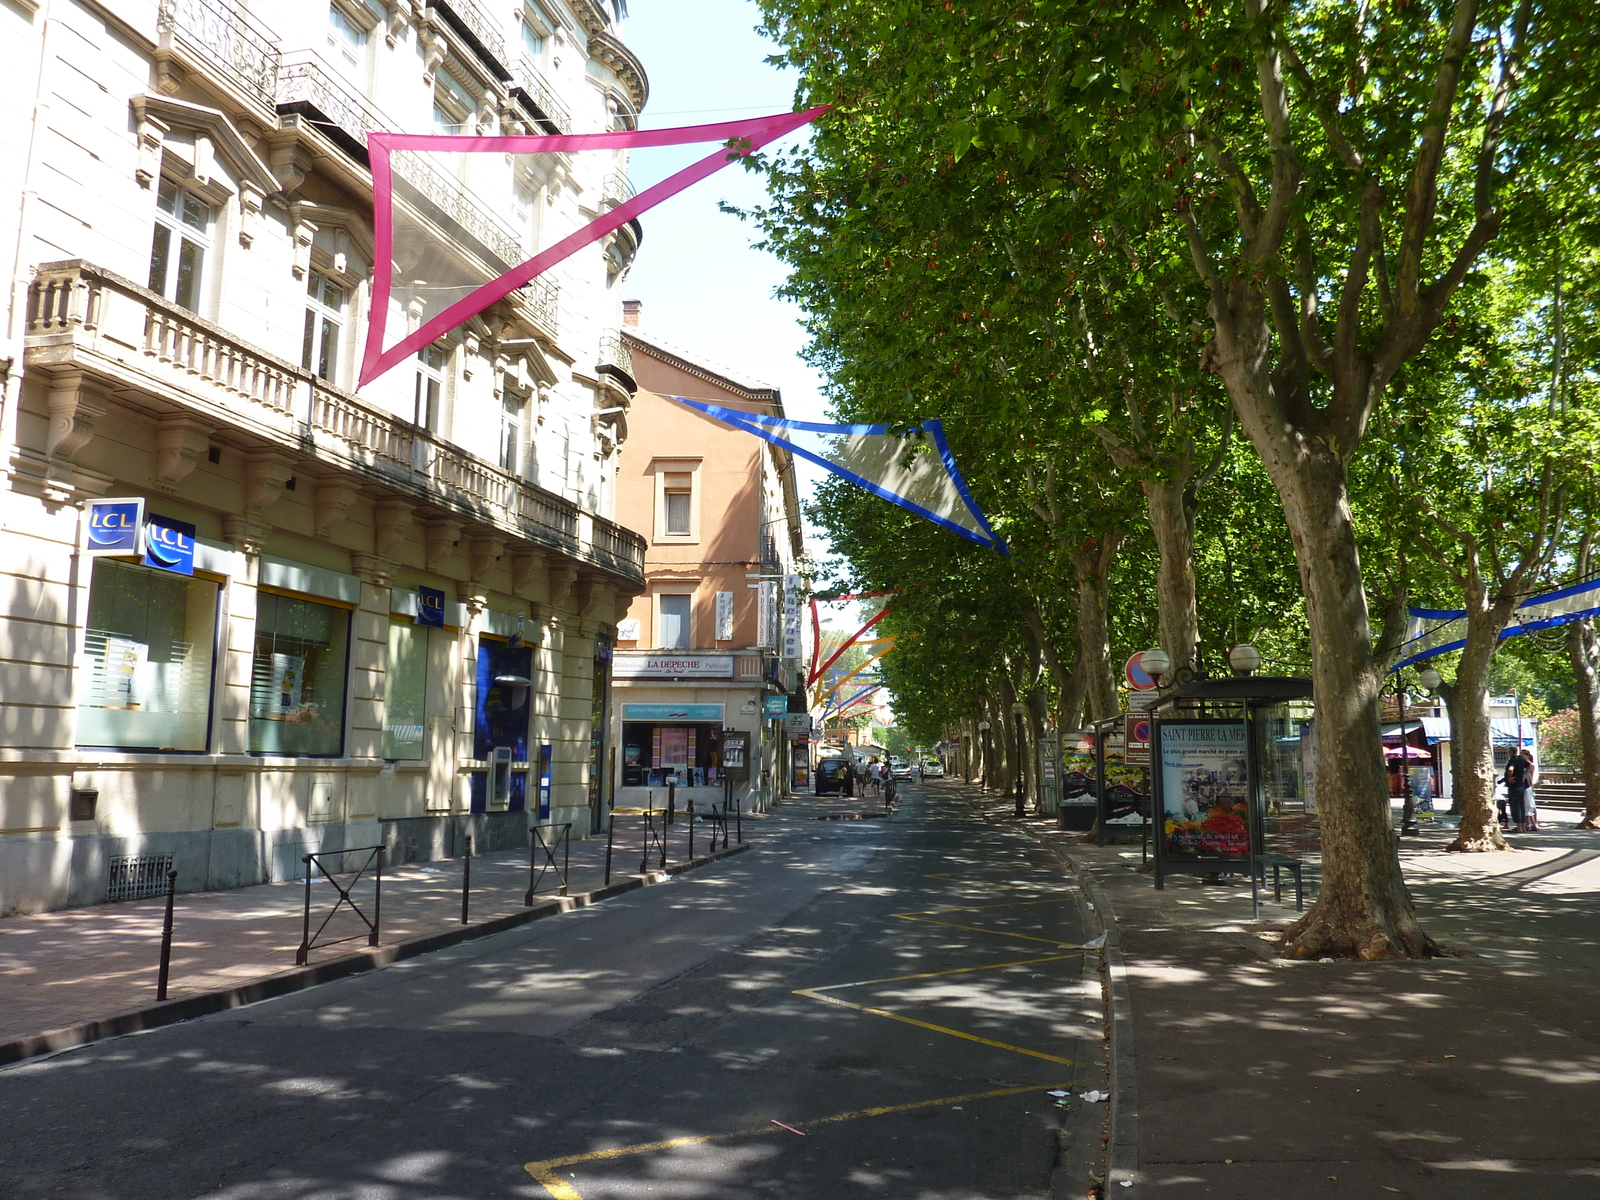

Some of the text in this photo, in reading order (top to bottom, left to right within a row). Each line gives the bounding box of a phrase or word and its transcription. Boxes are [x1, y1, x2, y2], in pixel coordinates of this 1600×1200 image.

[91, 513, 132, 528] LCL
[151, 523, 189, 550] LCL
[421, 594, 441, 610] LCL
[647, 661, 659, 669] LA
[1162, 728, 1187, 741] SAINT
[1188, 728, 1216, 741] PIERRE
[1217, 728, 1227, 741] LA
